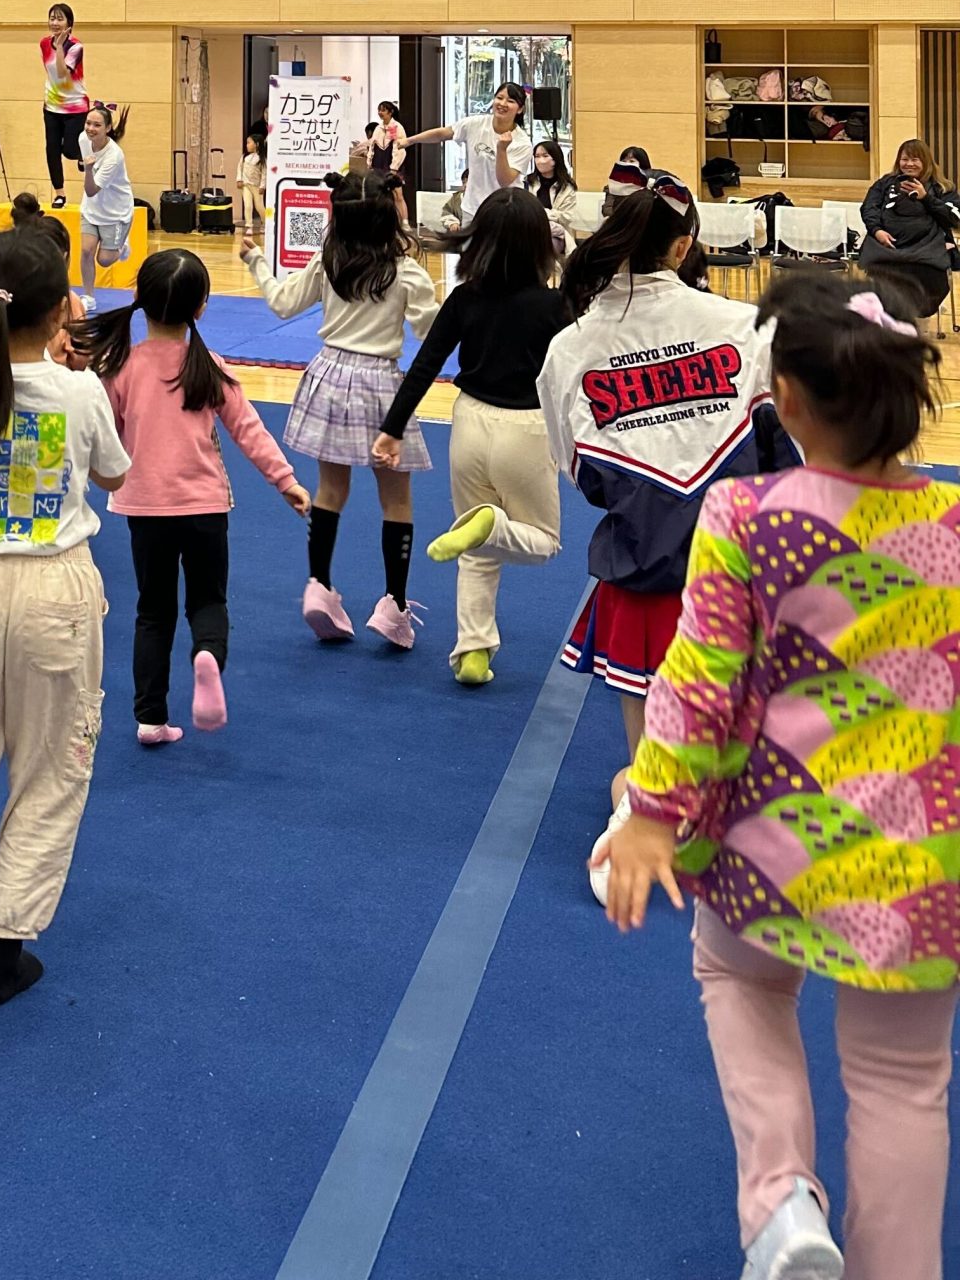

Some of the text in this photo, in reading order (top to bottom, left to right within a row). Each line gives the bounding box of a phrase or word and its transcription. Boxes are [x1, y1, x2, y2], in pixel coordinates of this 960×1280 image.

[280, 92, 340, 115] カラダ
[609, 341, 700, 368] CHUKYO UNIV.
[582, 343, 742, 430] SHEEP
[615, 401, 731, 432] CHEERLEADING TEAM
